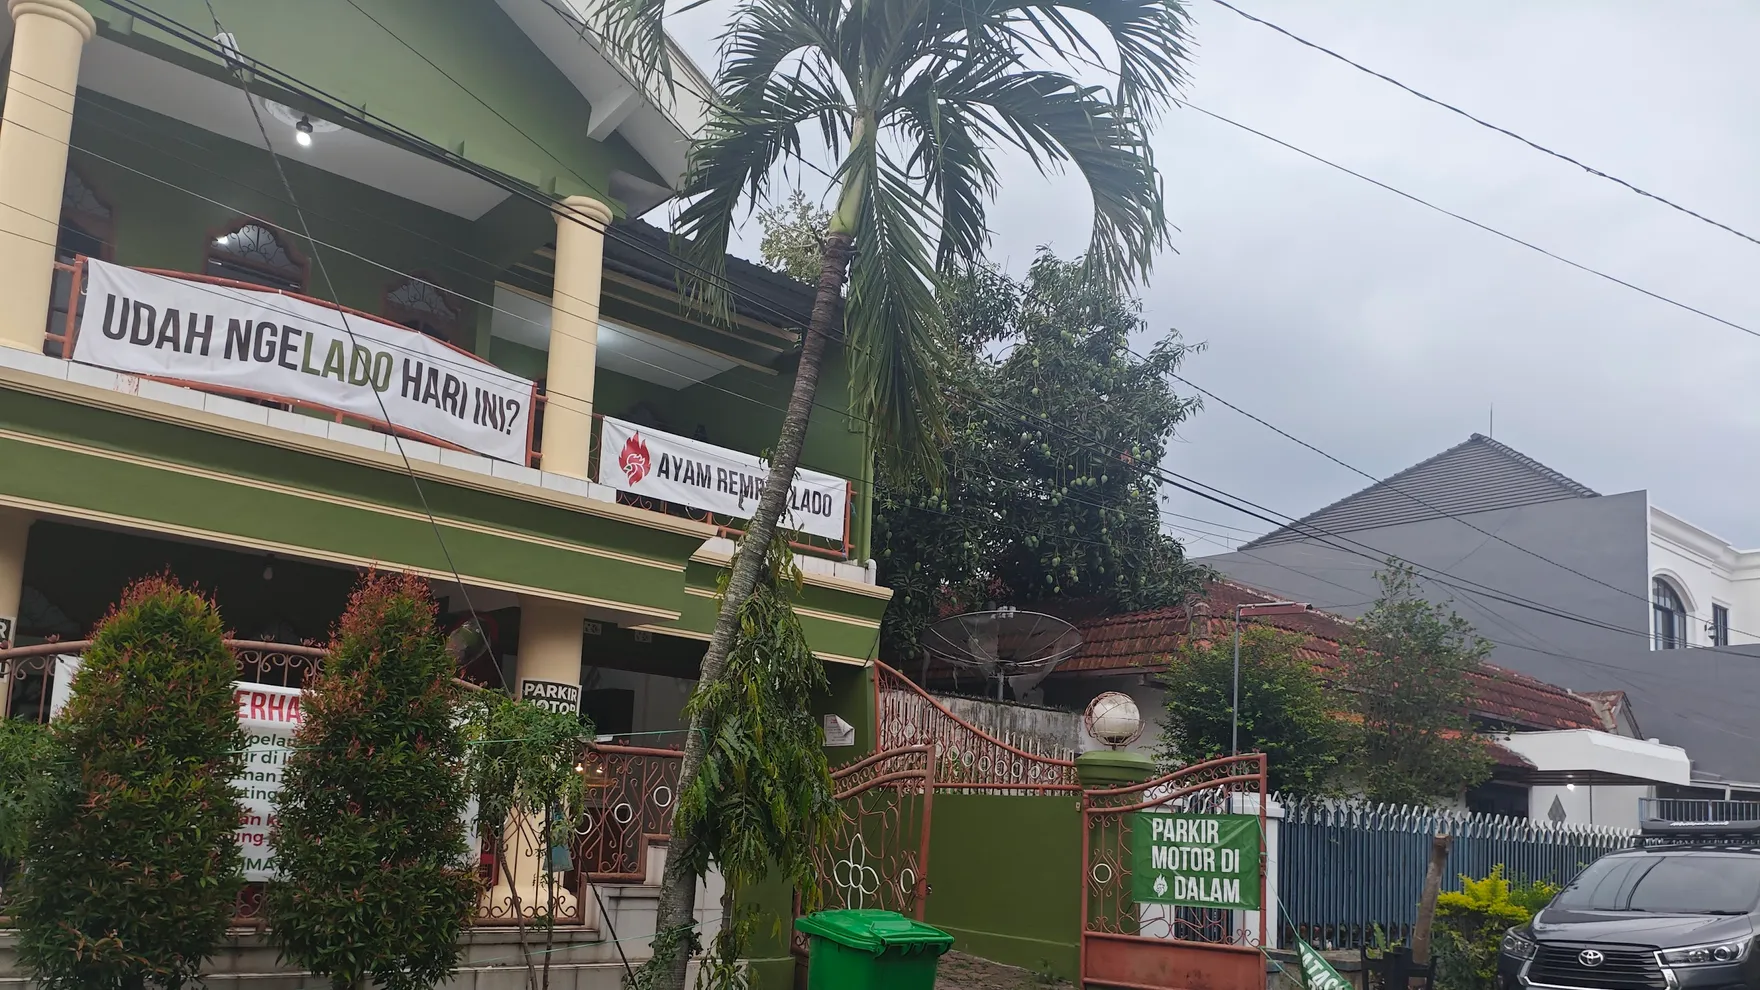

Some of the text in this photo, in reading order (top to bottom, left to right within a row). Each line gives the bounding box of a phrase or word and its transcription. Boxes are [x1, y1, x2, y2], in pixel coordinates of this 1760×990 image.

[102, 293, 520, 436] UDAH NGELADO HARI INI?
[657, 452, 833, 518] AYAM REMP LADO
[233, 689, 303, 724] ERHA
[524, 682, 578, 703] PARKIR
[261, 749, 278, 765] di
[1152, 817, 1220, 845] PARKIR
[1151, 845, 1240, 874] MOTOR DI
[1174, 875, 1240, 904] DALAM
